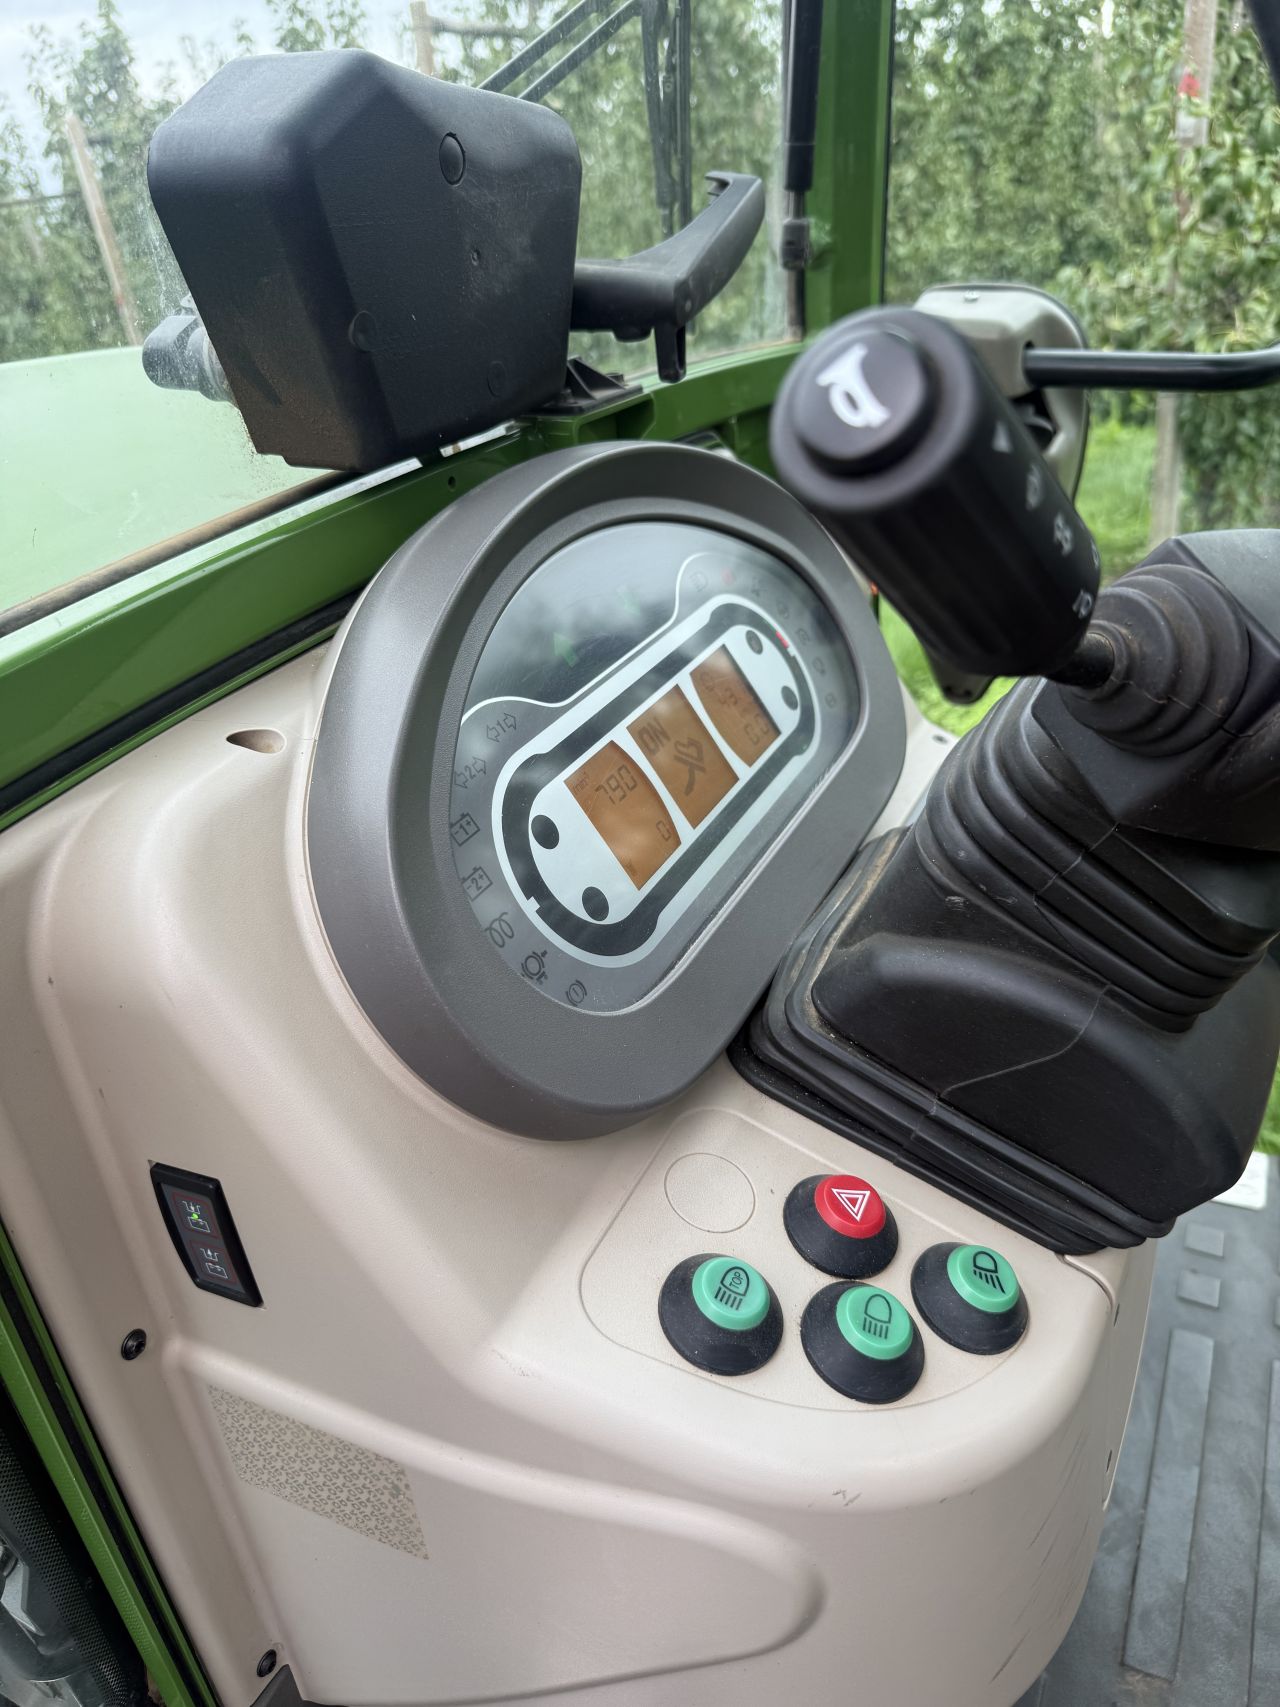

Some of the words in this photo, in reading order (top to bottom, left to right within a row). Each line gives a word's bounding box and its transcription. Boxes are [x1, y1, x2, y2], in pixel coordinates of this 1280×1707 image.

[638, 719, 670, 756] ON
[595, 764, 637, 804] 790
[656, 820, 671, 842] 0
[729, 1271, 743, 1289] TOP
